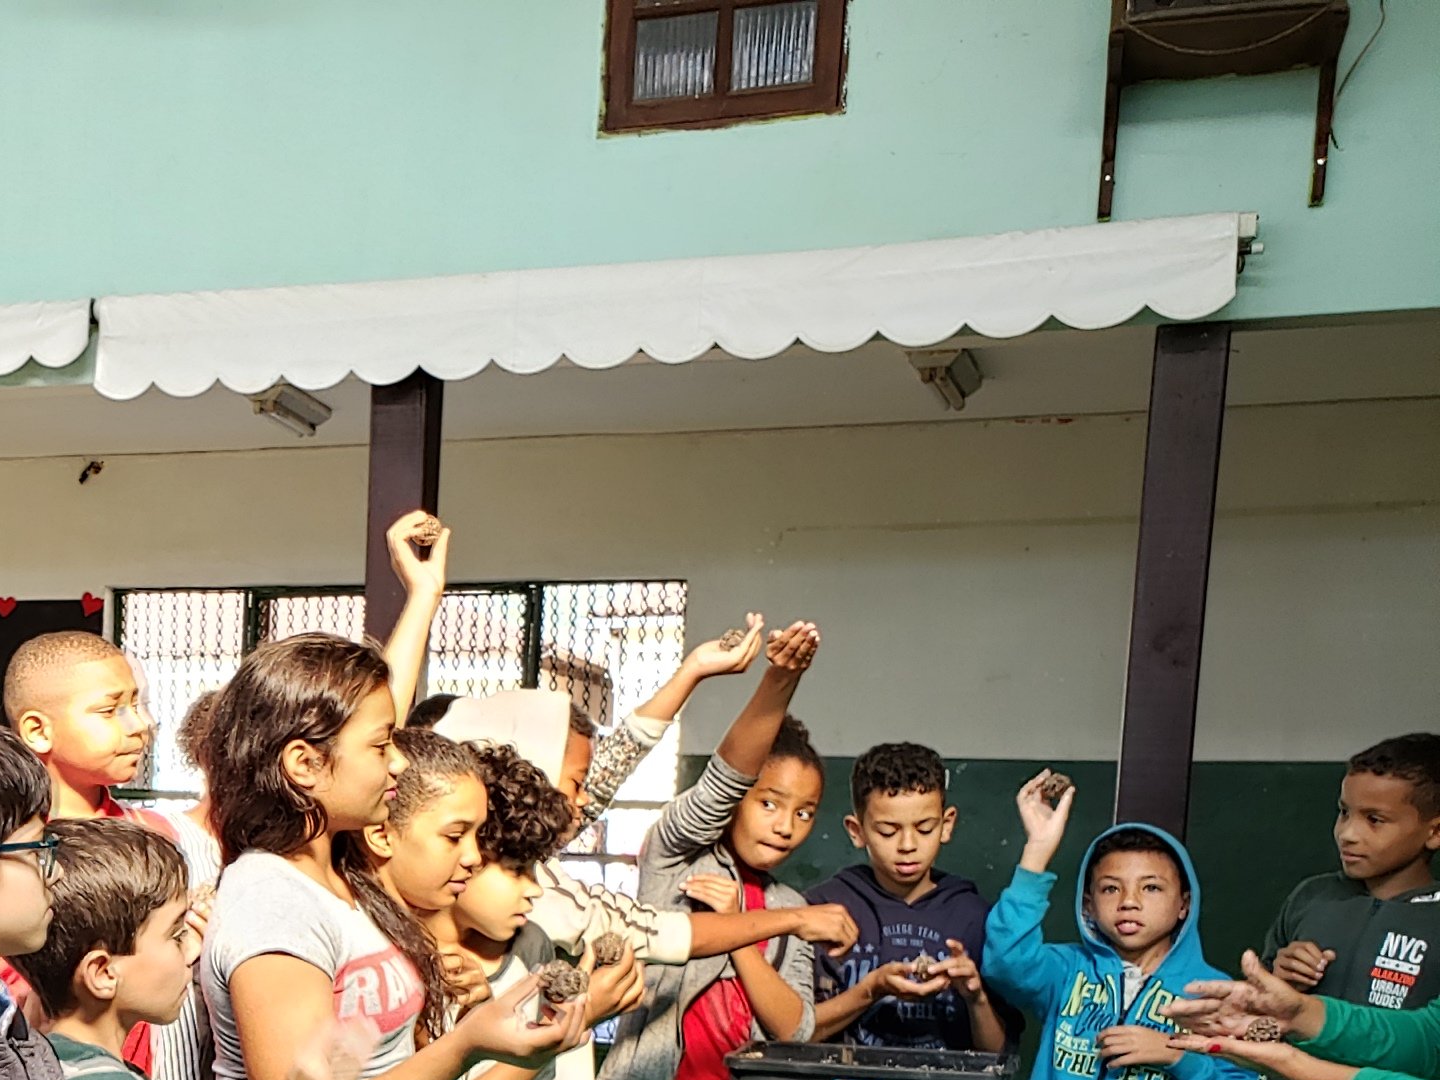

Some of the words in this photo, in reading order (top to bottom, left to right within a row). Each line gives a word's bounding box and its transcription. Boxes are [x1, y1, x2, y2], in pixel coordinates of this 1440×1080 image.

[882, 924, 913, 937] OLLEGE
[918, 926, 940, 942] TEAM
[1380, 932, 1428, 964] NYC
[1371, 978, 1409, 998] URBAN
[1368, 991, 1404, 1010] DUDES
